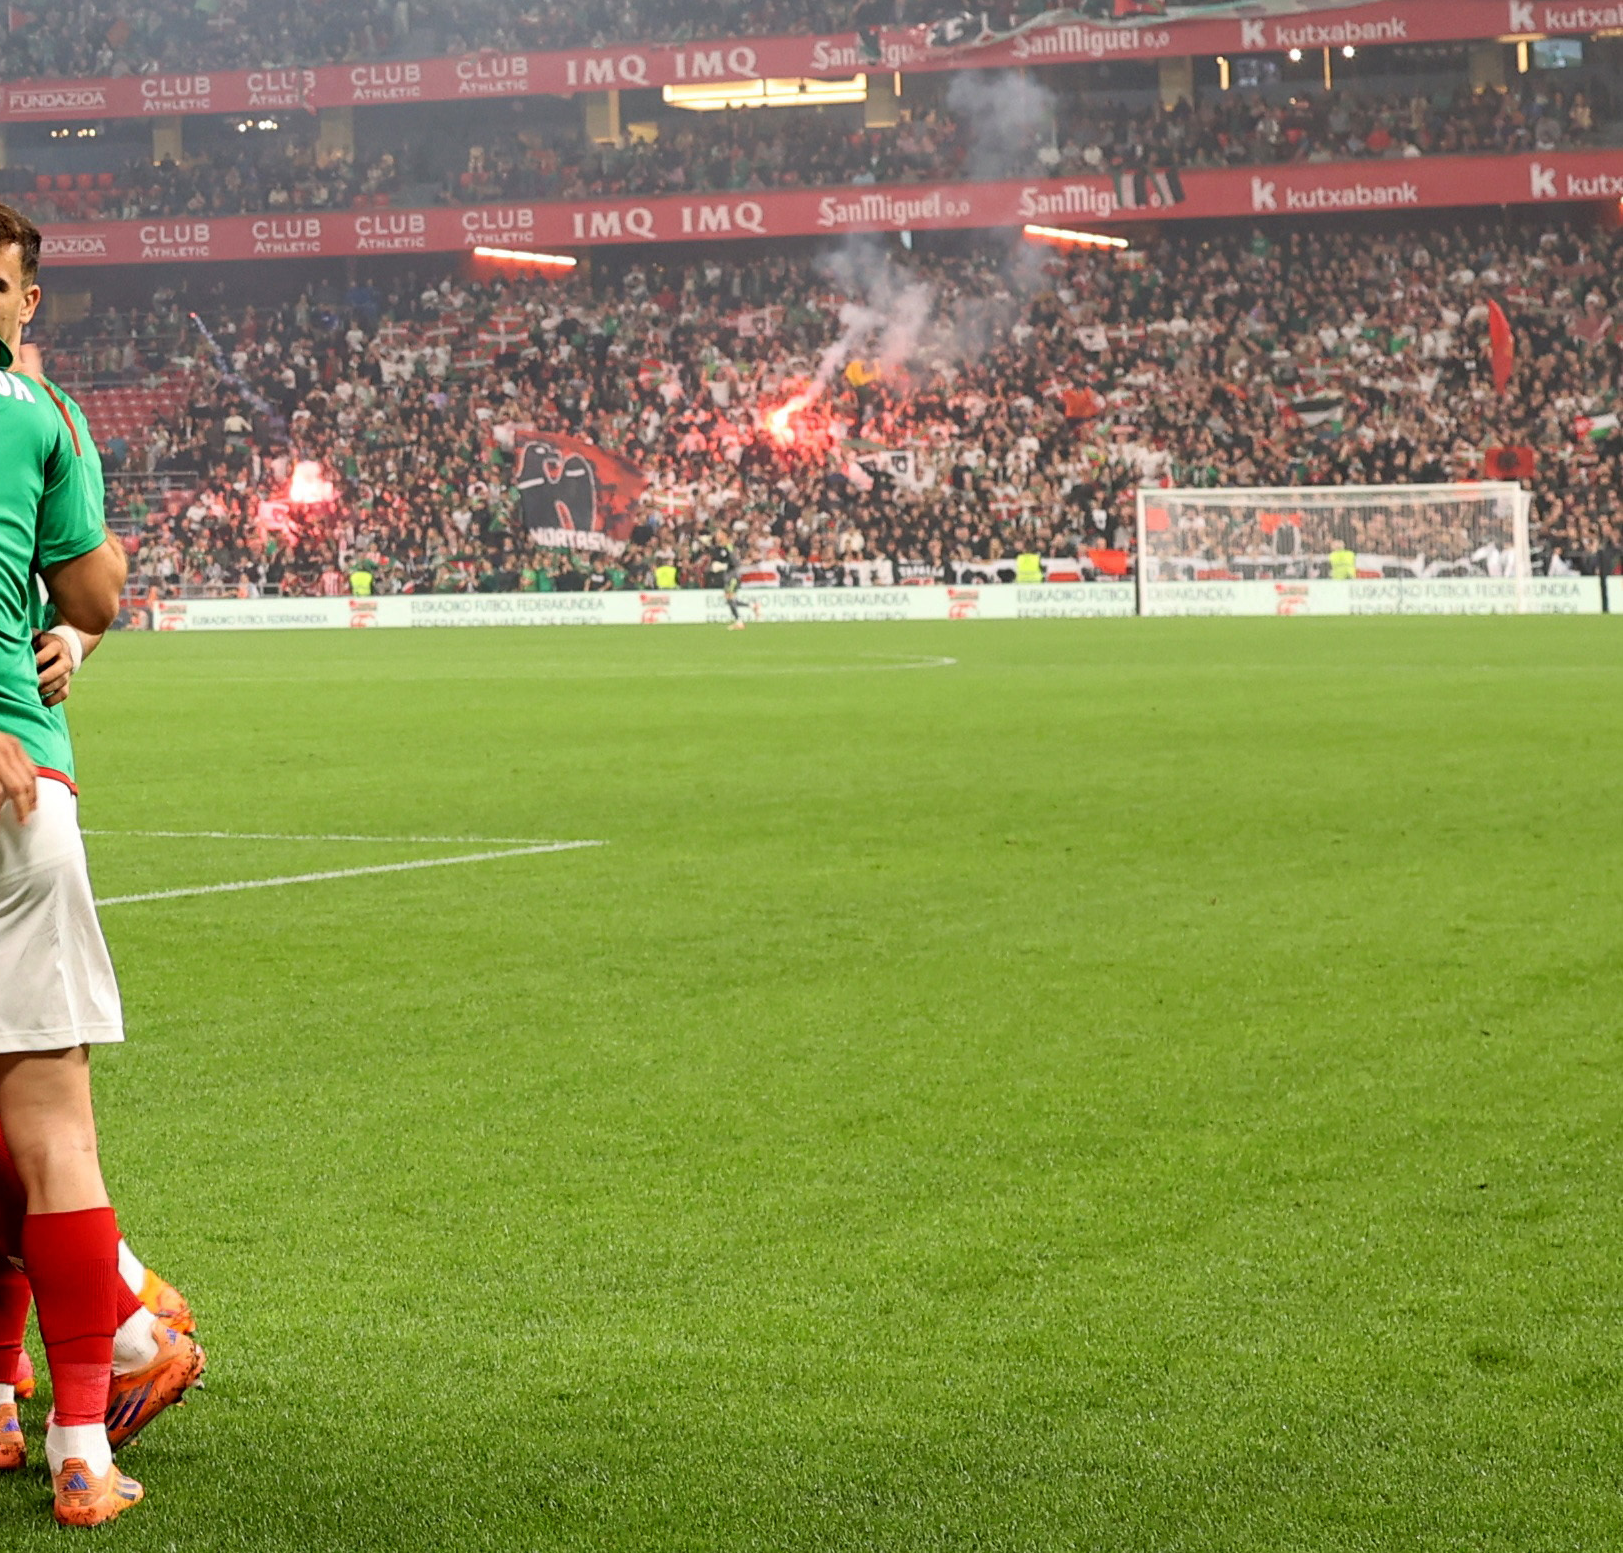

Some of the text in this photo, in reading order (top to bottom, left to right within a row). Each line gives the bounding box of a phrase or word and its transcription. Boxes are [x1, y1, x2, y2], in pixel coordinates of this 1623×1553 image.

[1274, 15, 1408, 47] kutxabank
[351, 64, 421, 87] CLUB
[456, 57, 528, 80] CLUB
[566, 46, 760, 86] IMQ IMQ
[141, 75, 211, 98] CLUB
[353, 87, 421, 101] ATHLETIC
[459, 80, 528, 94] ATHLETIC
[10, 90, 106, 110] FUNDAZIOA
[143, 98, 211, 112] ATHLETIC
[1286, 179, 1419, 209] kutxabank
[252, 218, 322, 240] CLUB
[355, 213, 426, 235] CLUB
[461, 208, 535, 231] CLUB
[573, 201, 767, 239] IMQ IMQ
[139, 223, 211, 244] CLUB
[357, 235, 426, 250] ATHLETIC
[464, 231, 534, 245] ATHLETIC
[141, 245, 210, 259] ATHLETIC
[255, 240, 321, 254] ATHLETIC
